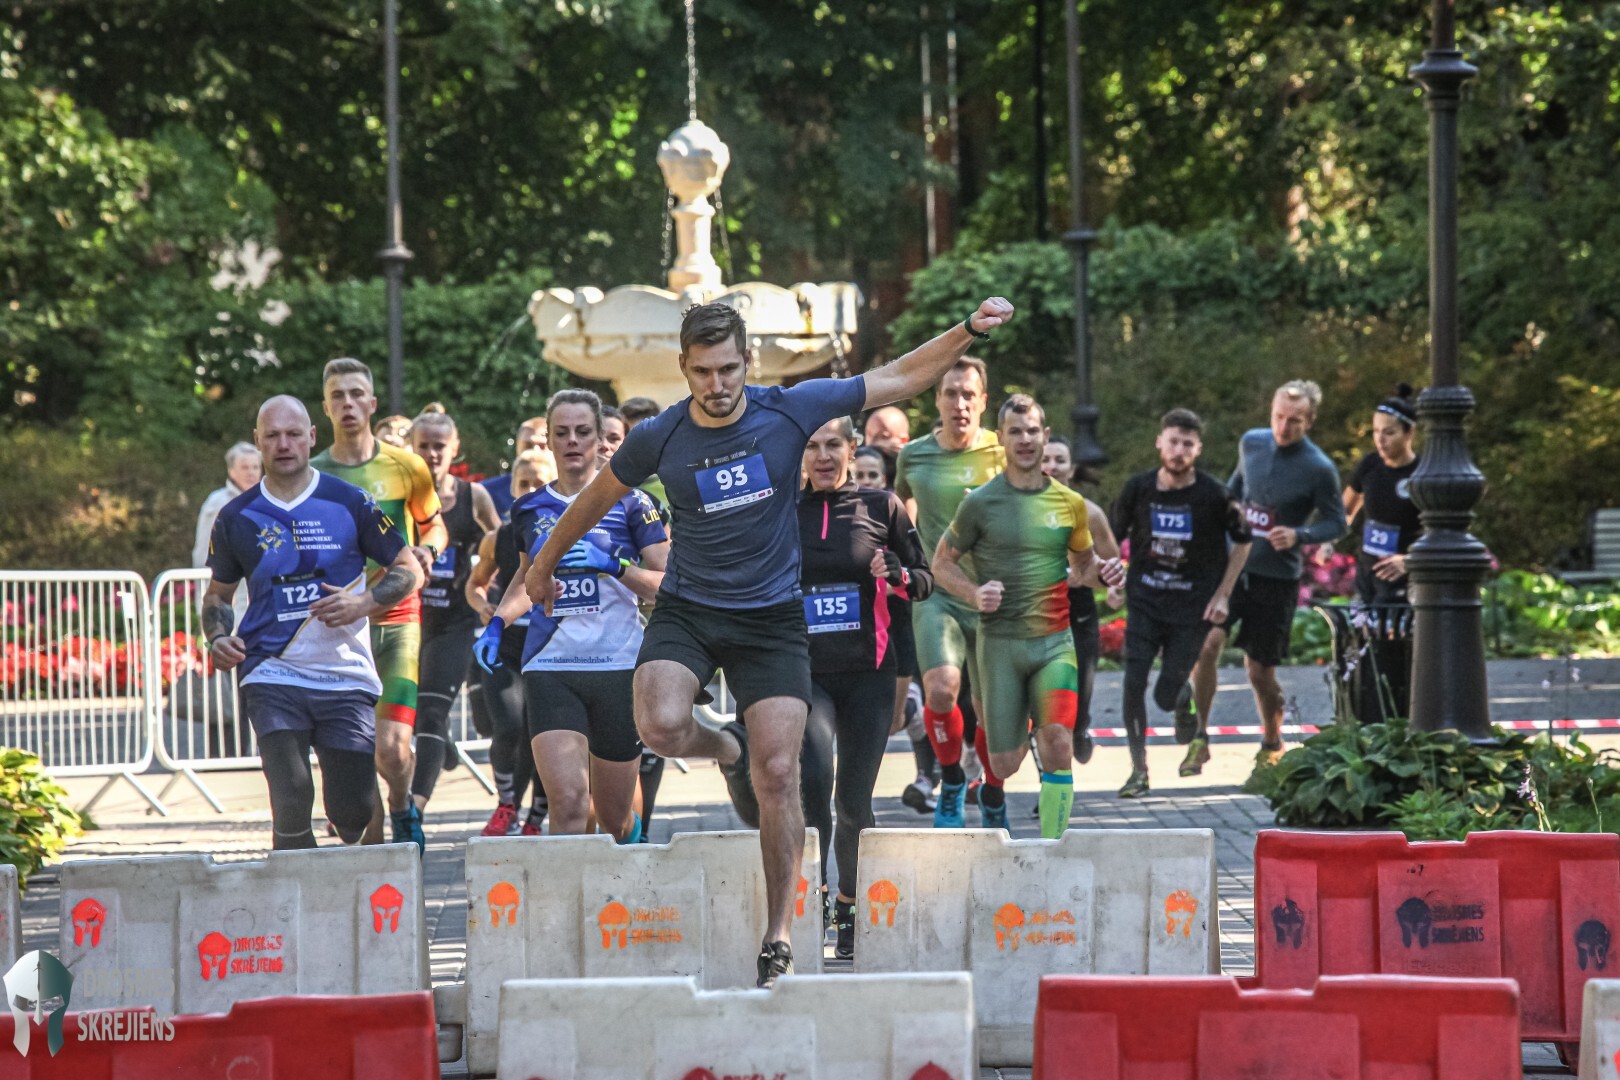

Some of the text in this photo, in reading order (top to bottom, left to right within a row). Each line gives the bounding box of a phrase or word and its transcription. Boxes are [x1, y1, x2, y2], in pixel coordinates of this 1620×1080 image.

[716, 464, 748, 490] 93
[1158, 513, 1185, 528] T75
[282, 583, 321, 605] T22
[813, 596, 848, 617] 135
